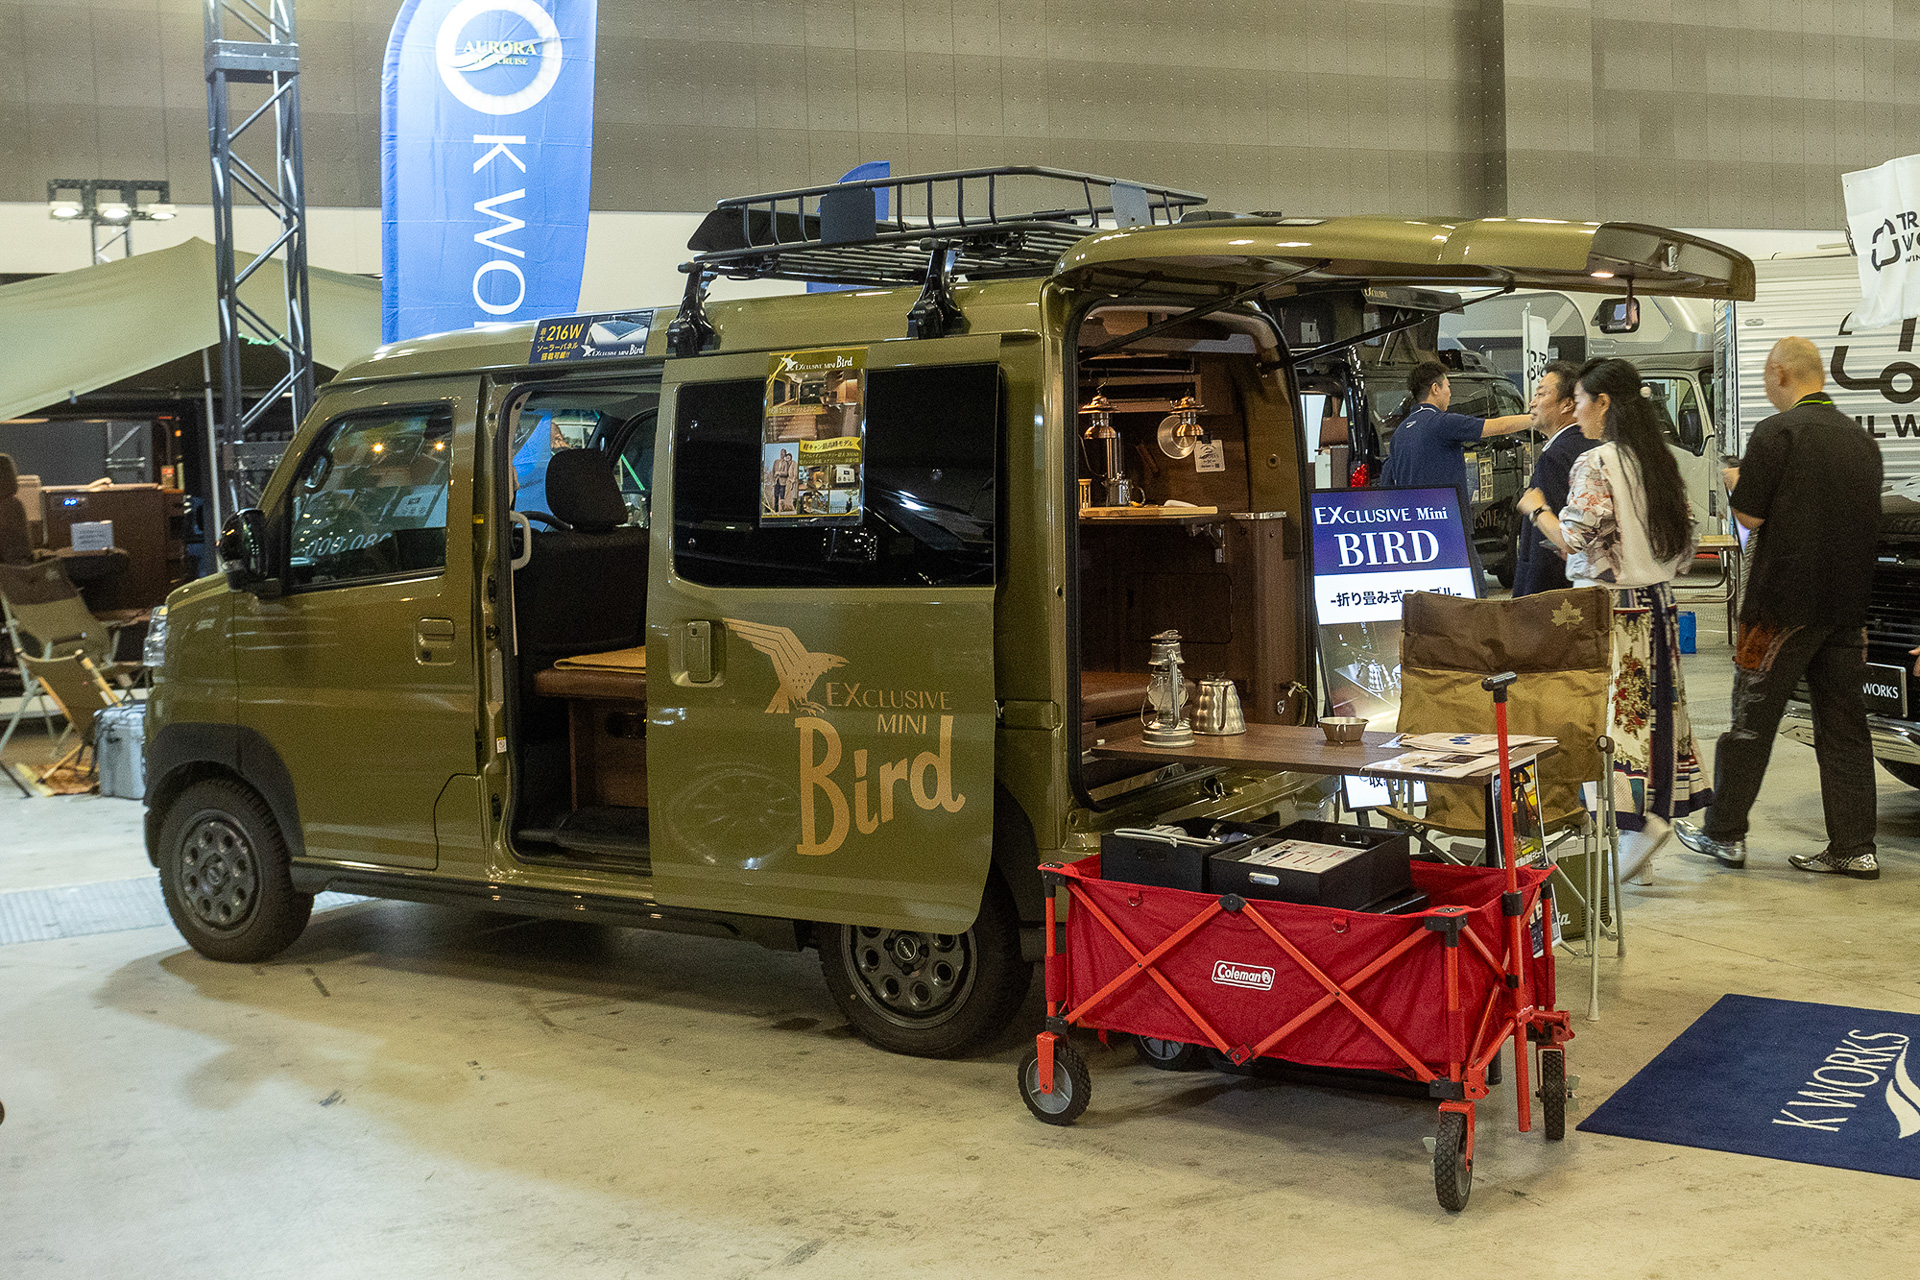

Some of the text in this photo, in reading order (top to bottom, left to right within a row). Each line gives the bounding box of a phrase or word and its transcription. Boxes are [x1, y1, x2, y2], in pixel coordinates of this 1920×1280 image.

[463, 40, 537, 55] AURORA
[472, 134, 526, 328] K WO
[546, 323, 584, 342] 216W
[629, 344, 644, 355] Bird
[836, 355, 853, 369] Bird
[1314, 506, 1448, 525] EXCLUSIVE Mini
[1333, 530, 1440, 567] BIRD
[826, 682, 952, 710] EXCLUSIVE
[1862, 683, 1899, 699] WORKS
[877, 713, 927, 734] MINI
[794, 715, 966, 856] Bird
[1217, 964, 1261, 983] Coleman
[1772, 1029, 1910, 1131] K WORKS
